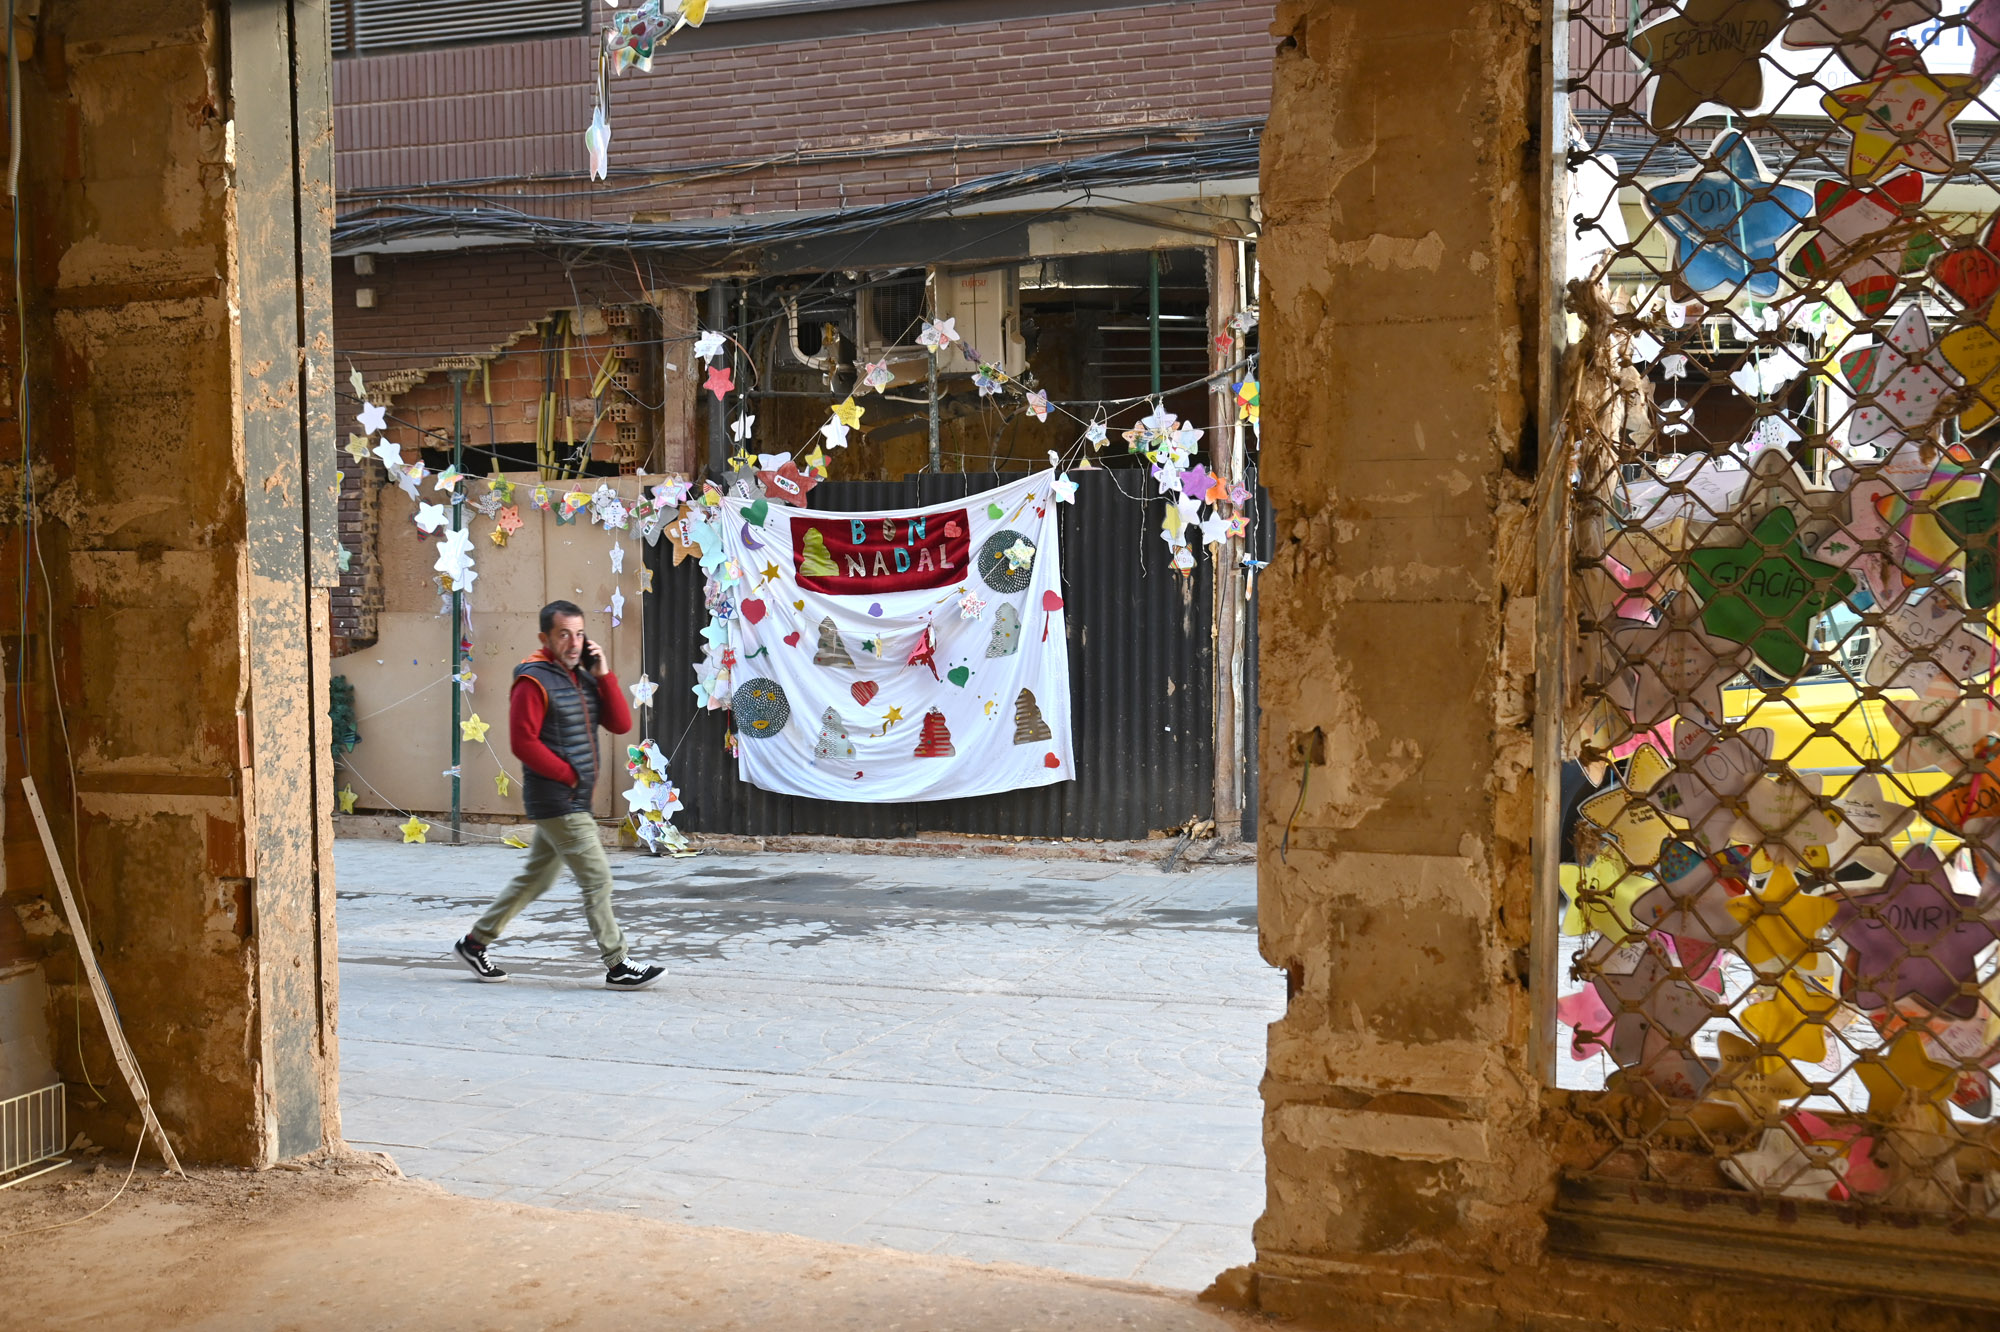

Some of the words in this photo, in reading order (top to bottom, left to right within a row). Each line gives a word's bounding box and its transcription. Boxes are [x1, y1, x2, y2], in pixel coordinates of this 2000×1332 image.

[1663, 20, 1768, 59] ESPERANZA
[1687, 189, 1747, 214] TODO
[850, 517, 927, 547] BON
[844, 543, 955, 578] NADAL
